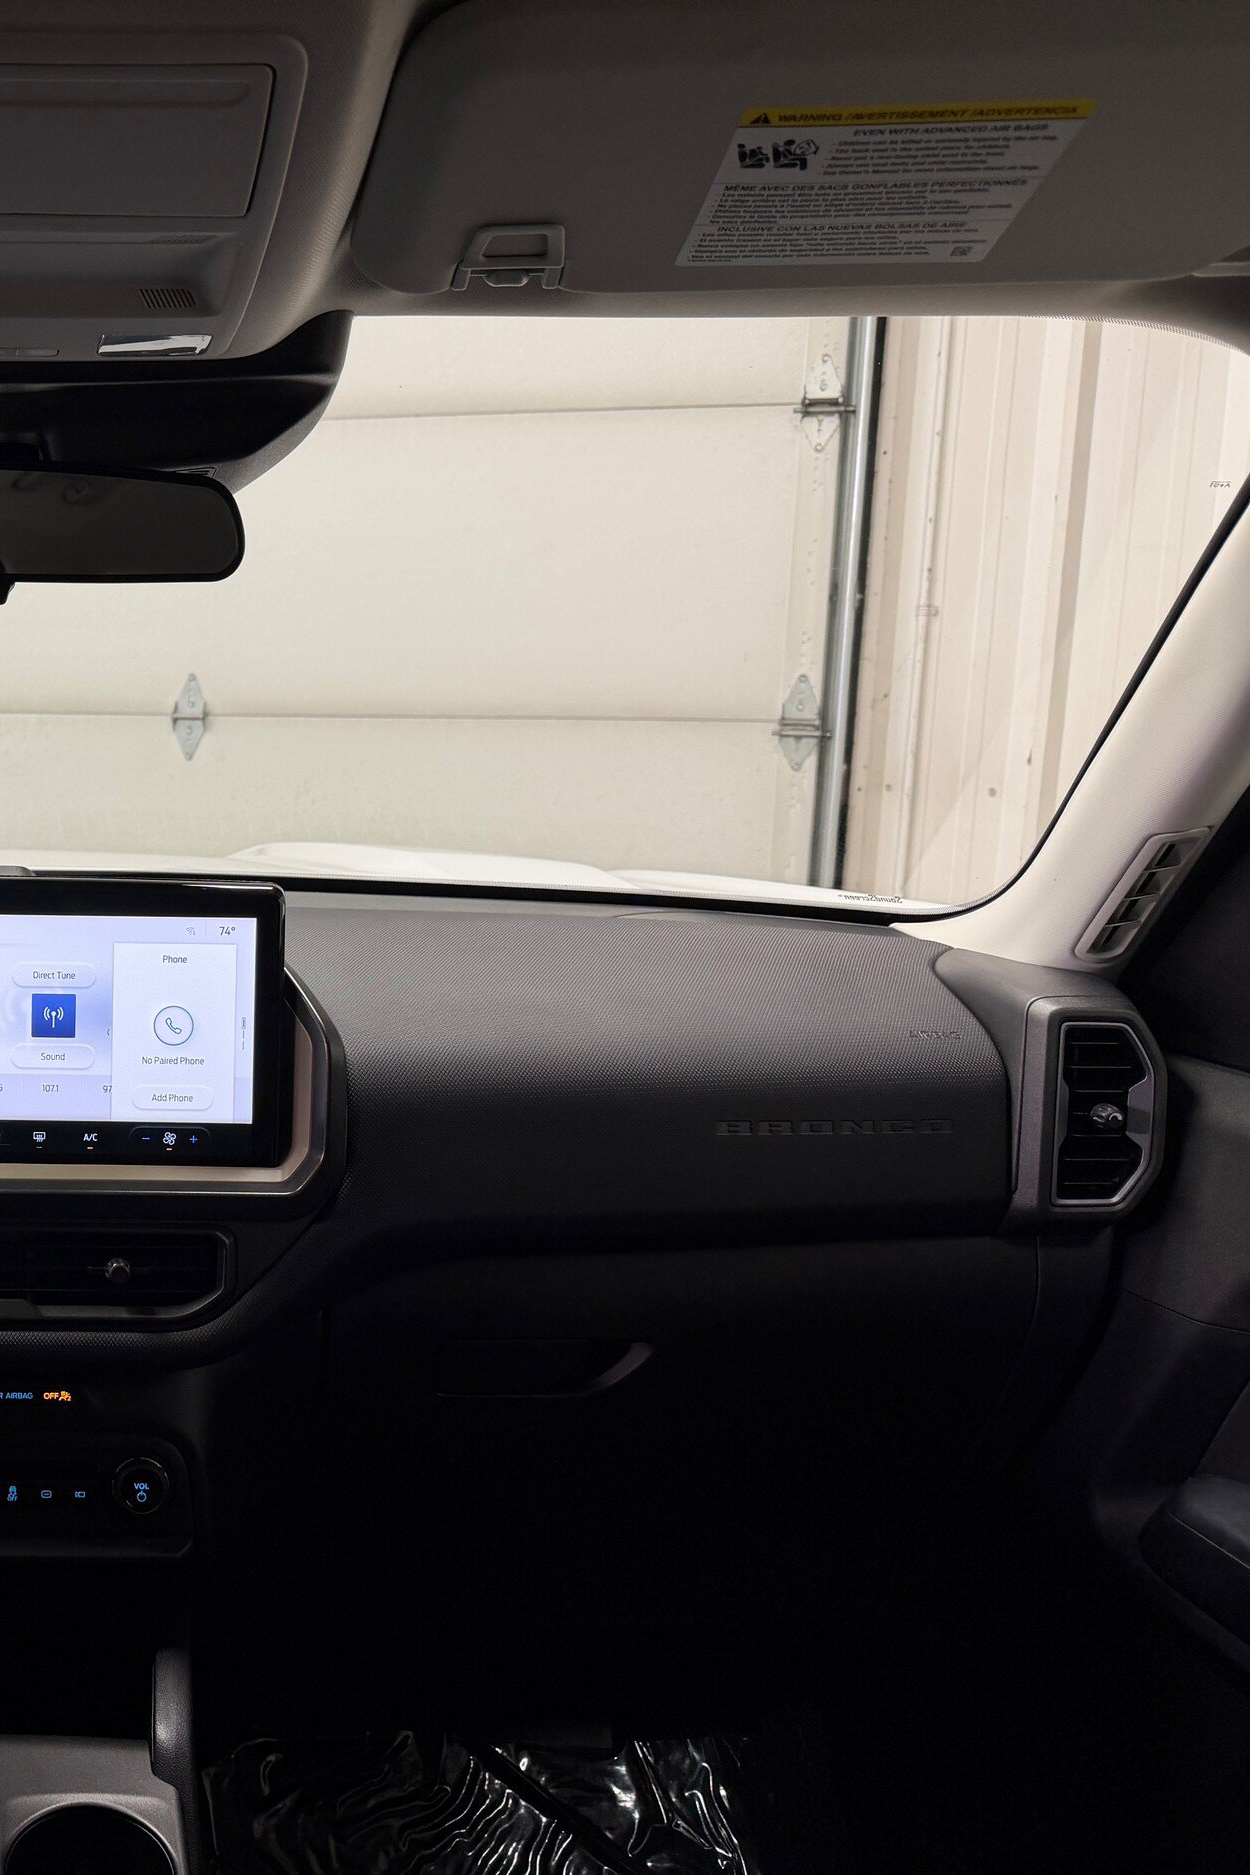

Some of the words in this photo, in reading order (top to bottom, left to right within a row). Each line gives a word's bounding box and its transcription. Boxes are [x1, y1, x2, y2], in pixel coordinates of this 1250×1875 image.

[162, 955, 188, 964] Phone
[32, 971, 55, 980] Direct
[56, 971, 76, 980] Tune
[40, 1052, 66, 1061] Sound
[141, 1056, 154, 1065] No
[155, 1056, 178, 1066] Paired
[180, 1057, 205, 1066] Phone
[42, 1083, 60, 1093] 107.1
[151, 1093, 168, 1102] Add
[169, 1093, 194, 1103] Phone
[716, 1118, 954, 1136] BRONCO
[83, 1132, 98, 1142] A/C
[5, 1391, 34, 1400] AIRBAG
[42, 1391, 59, 1401] OFF
[134, 1482, 150, 1491] VOL
